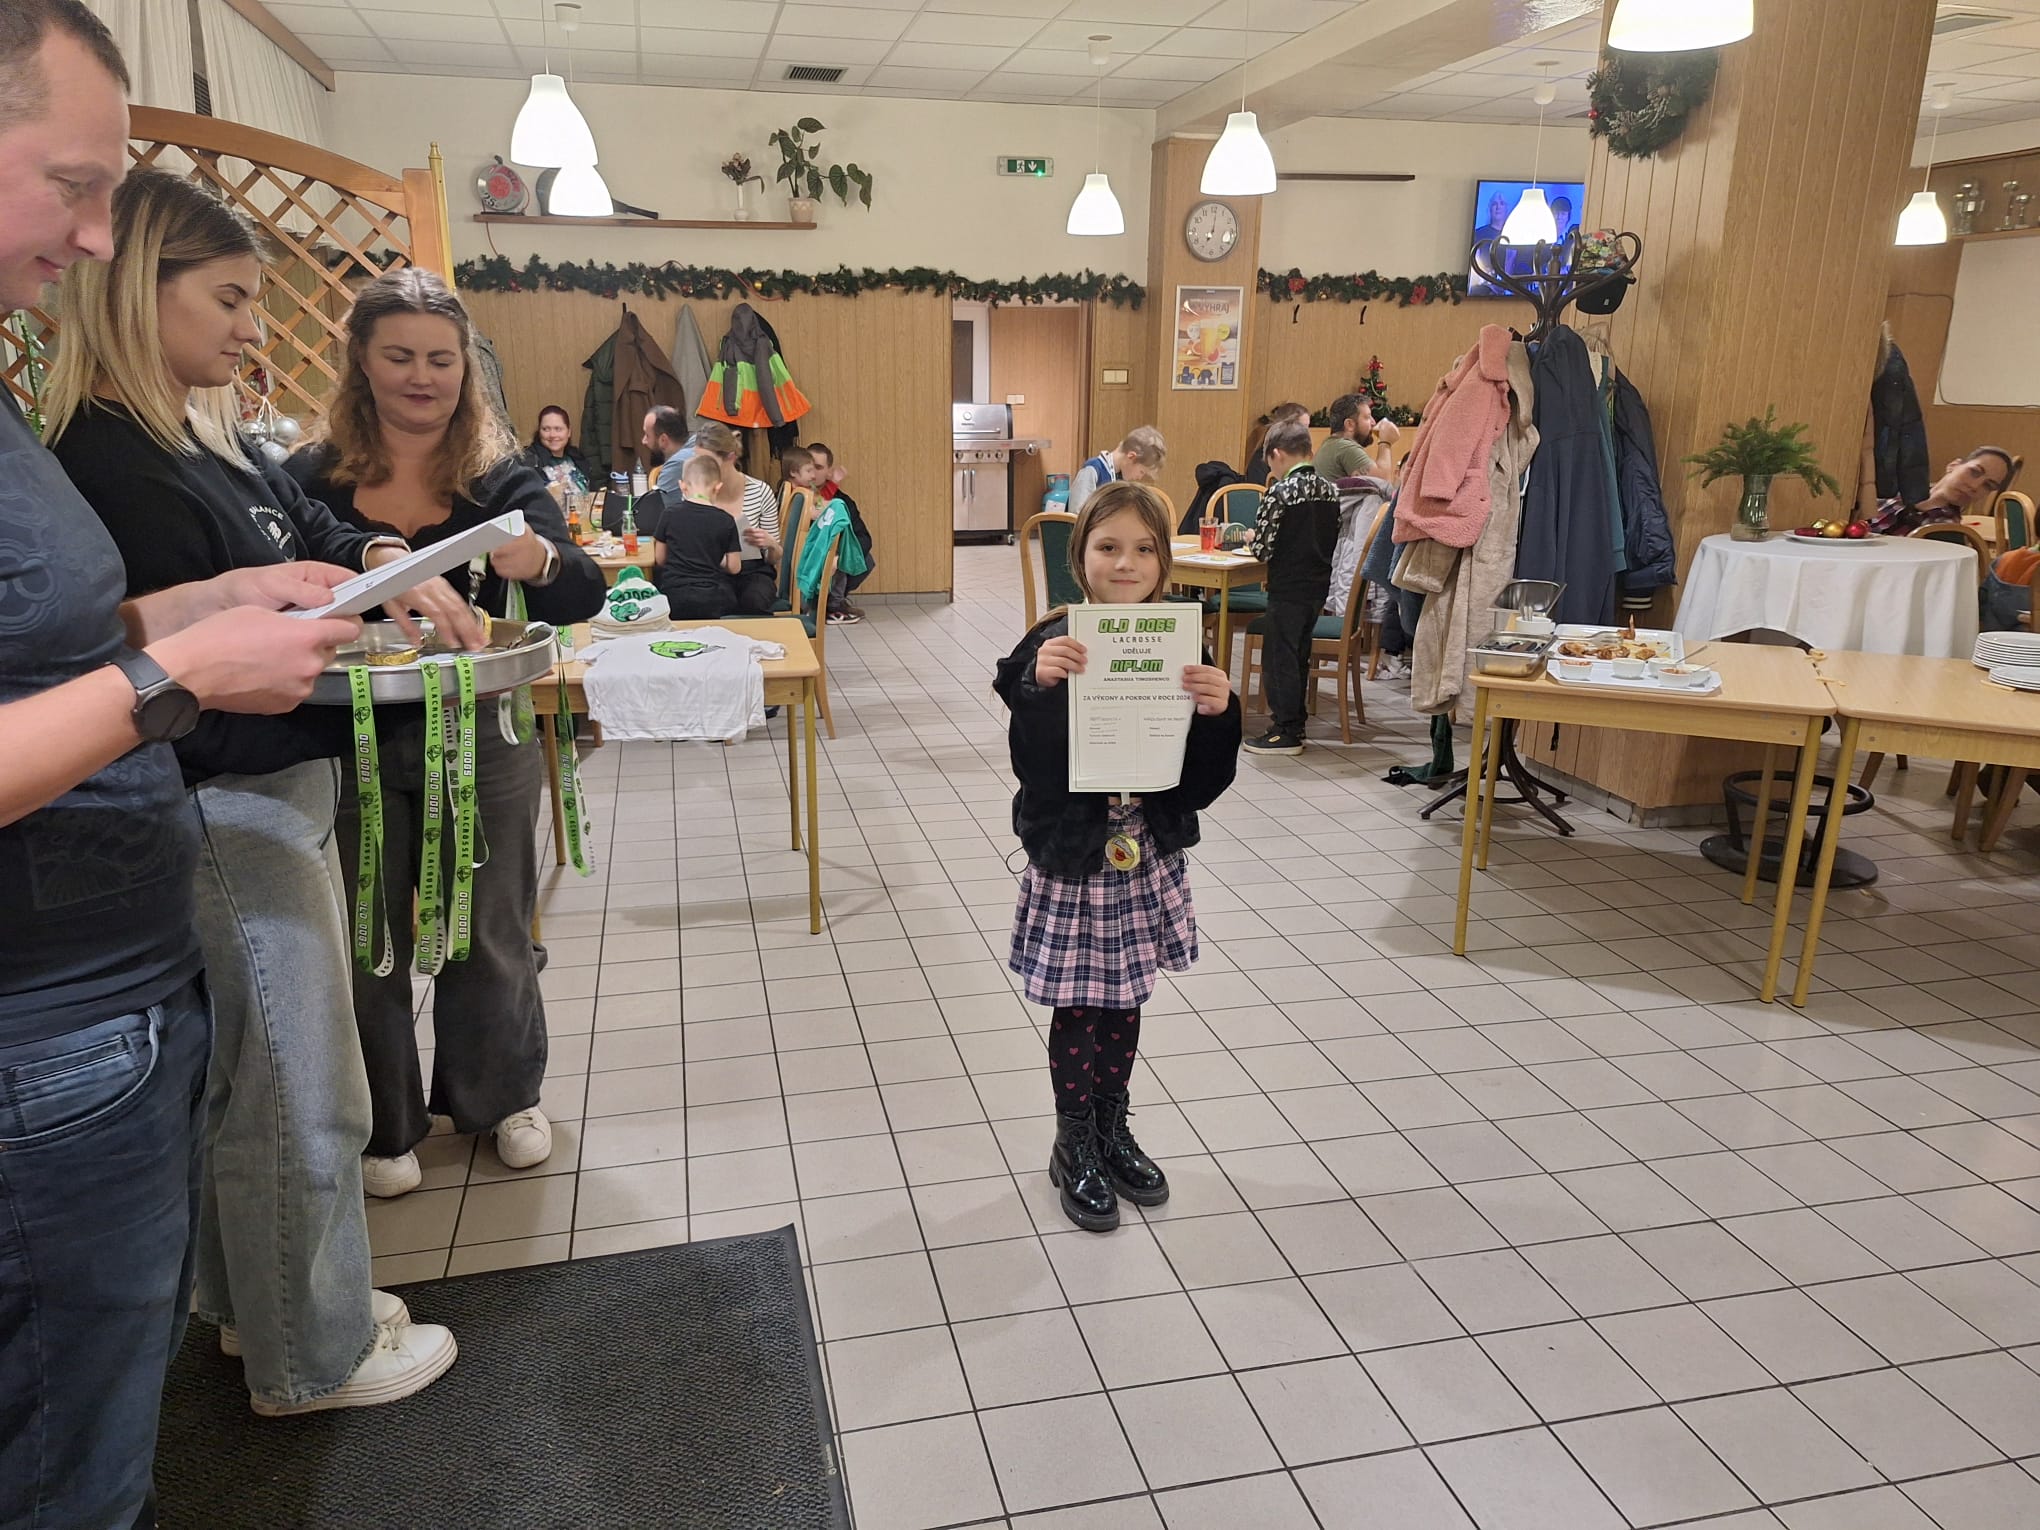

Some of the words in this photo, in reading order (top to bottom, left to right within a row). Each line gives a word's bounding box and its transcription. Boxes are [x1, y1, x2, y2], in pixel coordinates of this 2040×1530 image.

[1098, 618, 1130, 633] OLD
[1135, 618, 1176, 633] DOGS
[1112, 636, 1163, 644] LACROSSE
[1122, 647, 1152, 655] UDĚLUJE
[1110, 659, 1164, 673] DIPLOM
[430, 686, 439, 738] LACROSSE
[359, 734, 370, 754] OLD
[463, 728, 473, 747] OLD
[360, 757, 371, 784] DOGS
[463, 751, 473, 777] DOGS
[429, 771, 440, 790] OLD
[428, 794, 440, 820] DOGS
[461, 809, 470, 858] LACROSSE
[459, 891, 468, 910] OLD
[458, 914, 468, 940] DOGS
[420, 933, 431, 953] OLD
